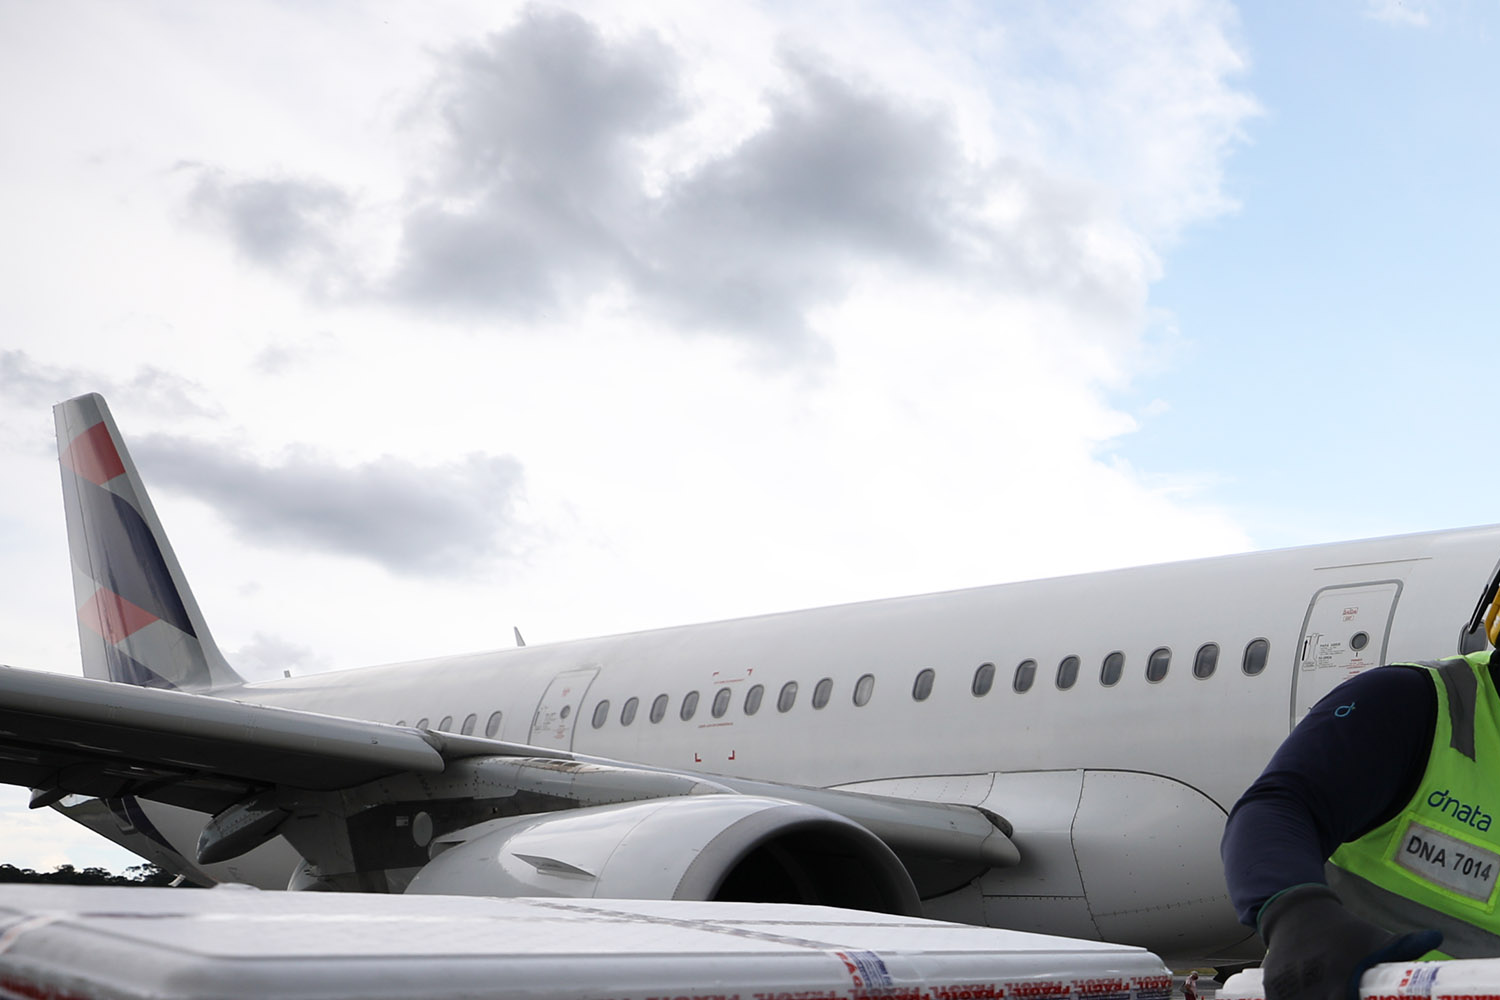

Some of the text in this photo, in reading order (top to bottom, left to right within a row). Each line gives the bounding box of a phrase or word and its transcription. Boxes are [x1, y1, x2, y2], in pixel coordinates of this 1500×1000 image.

[1427, 789, 1493, 832] dnata
[1406, 835, 1493, 881] DNA 7014
